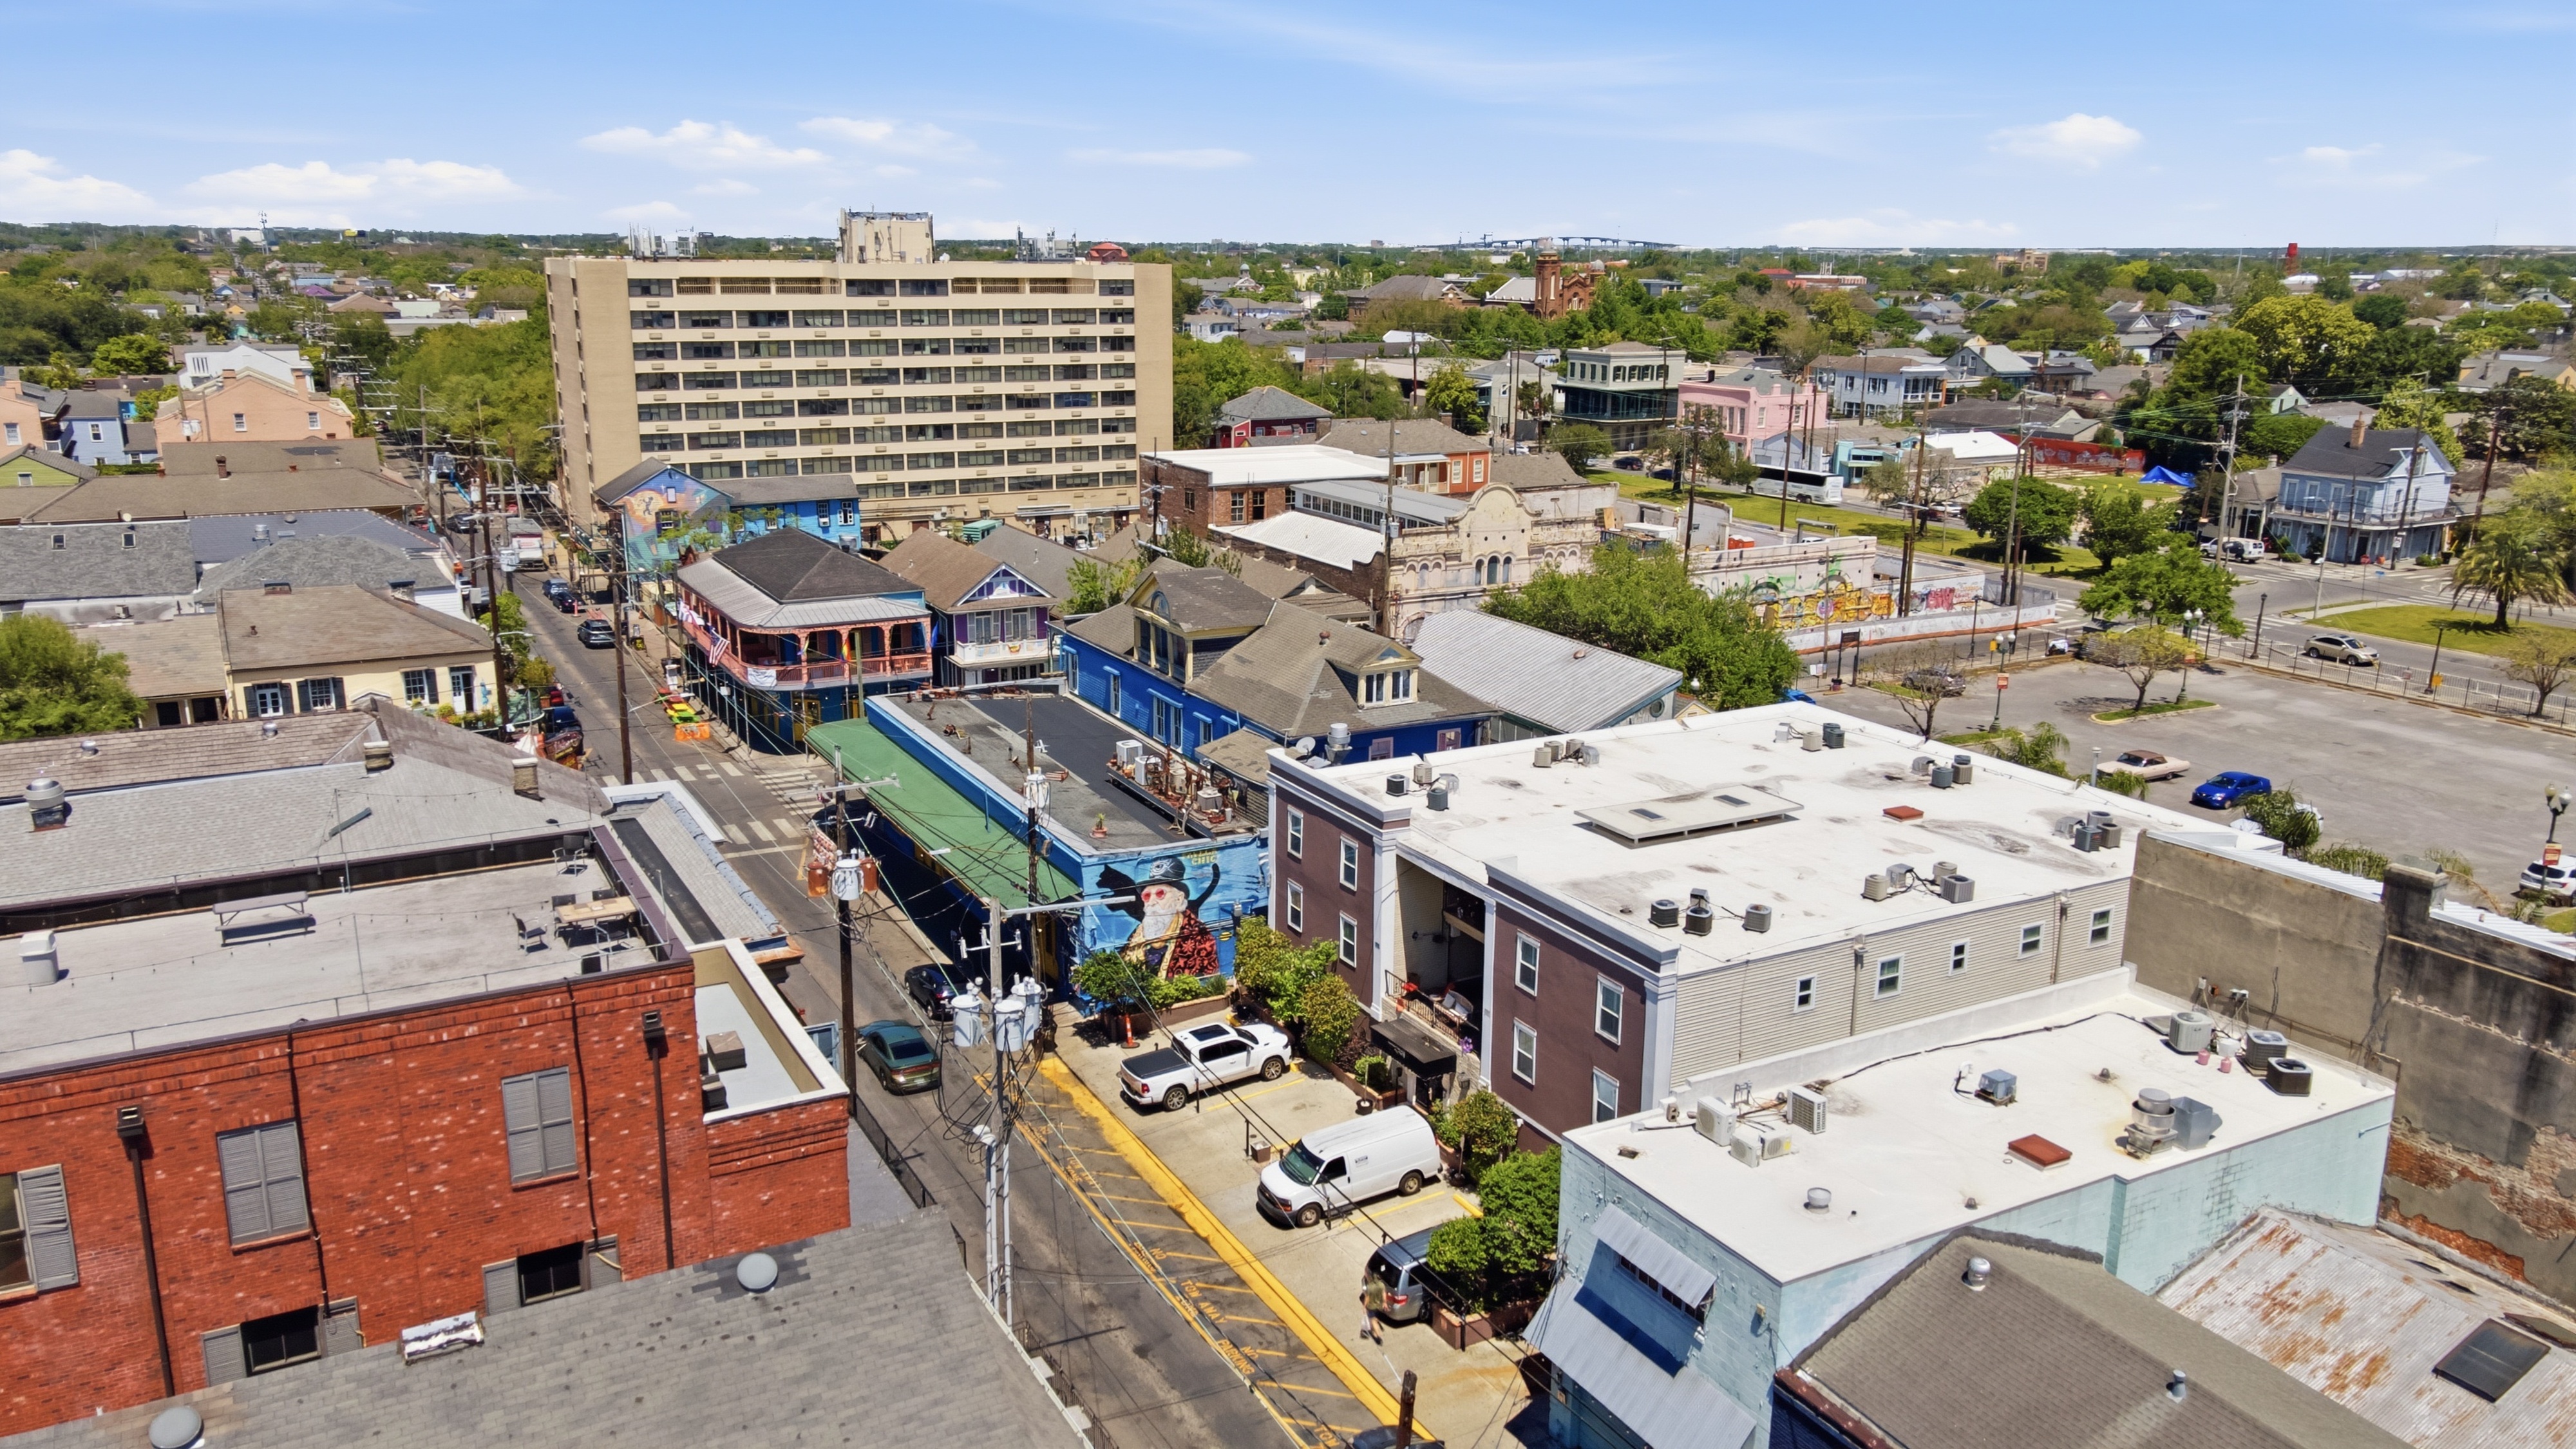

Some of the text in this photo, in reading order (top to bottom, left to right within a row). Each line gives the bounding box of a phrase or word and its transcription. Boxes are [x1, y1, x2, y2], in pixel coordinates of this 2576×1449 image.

[1150, 1247, 1167, 1260] NO
[1180, 1279, 1228, 1323] TOW AWAY
[1217, 1339, 1255, 1375] PARKING
[1240, 1345, 1259, 1360] NO
[1314, 1424, 1340, 1448] TOW
